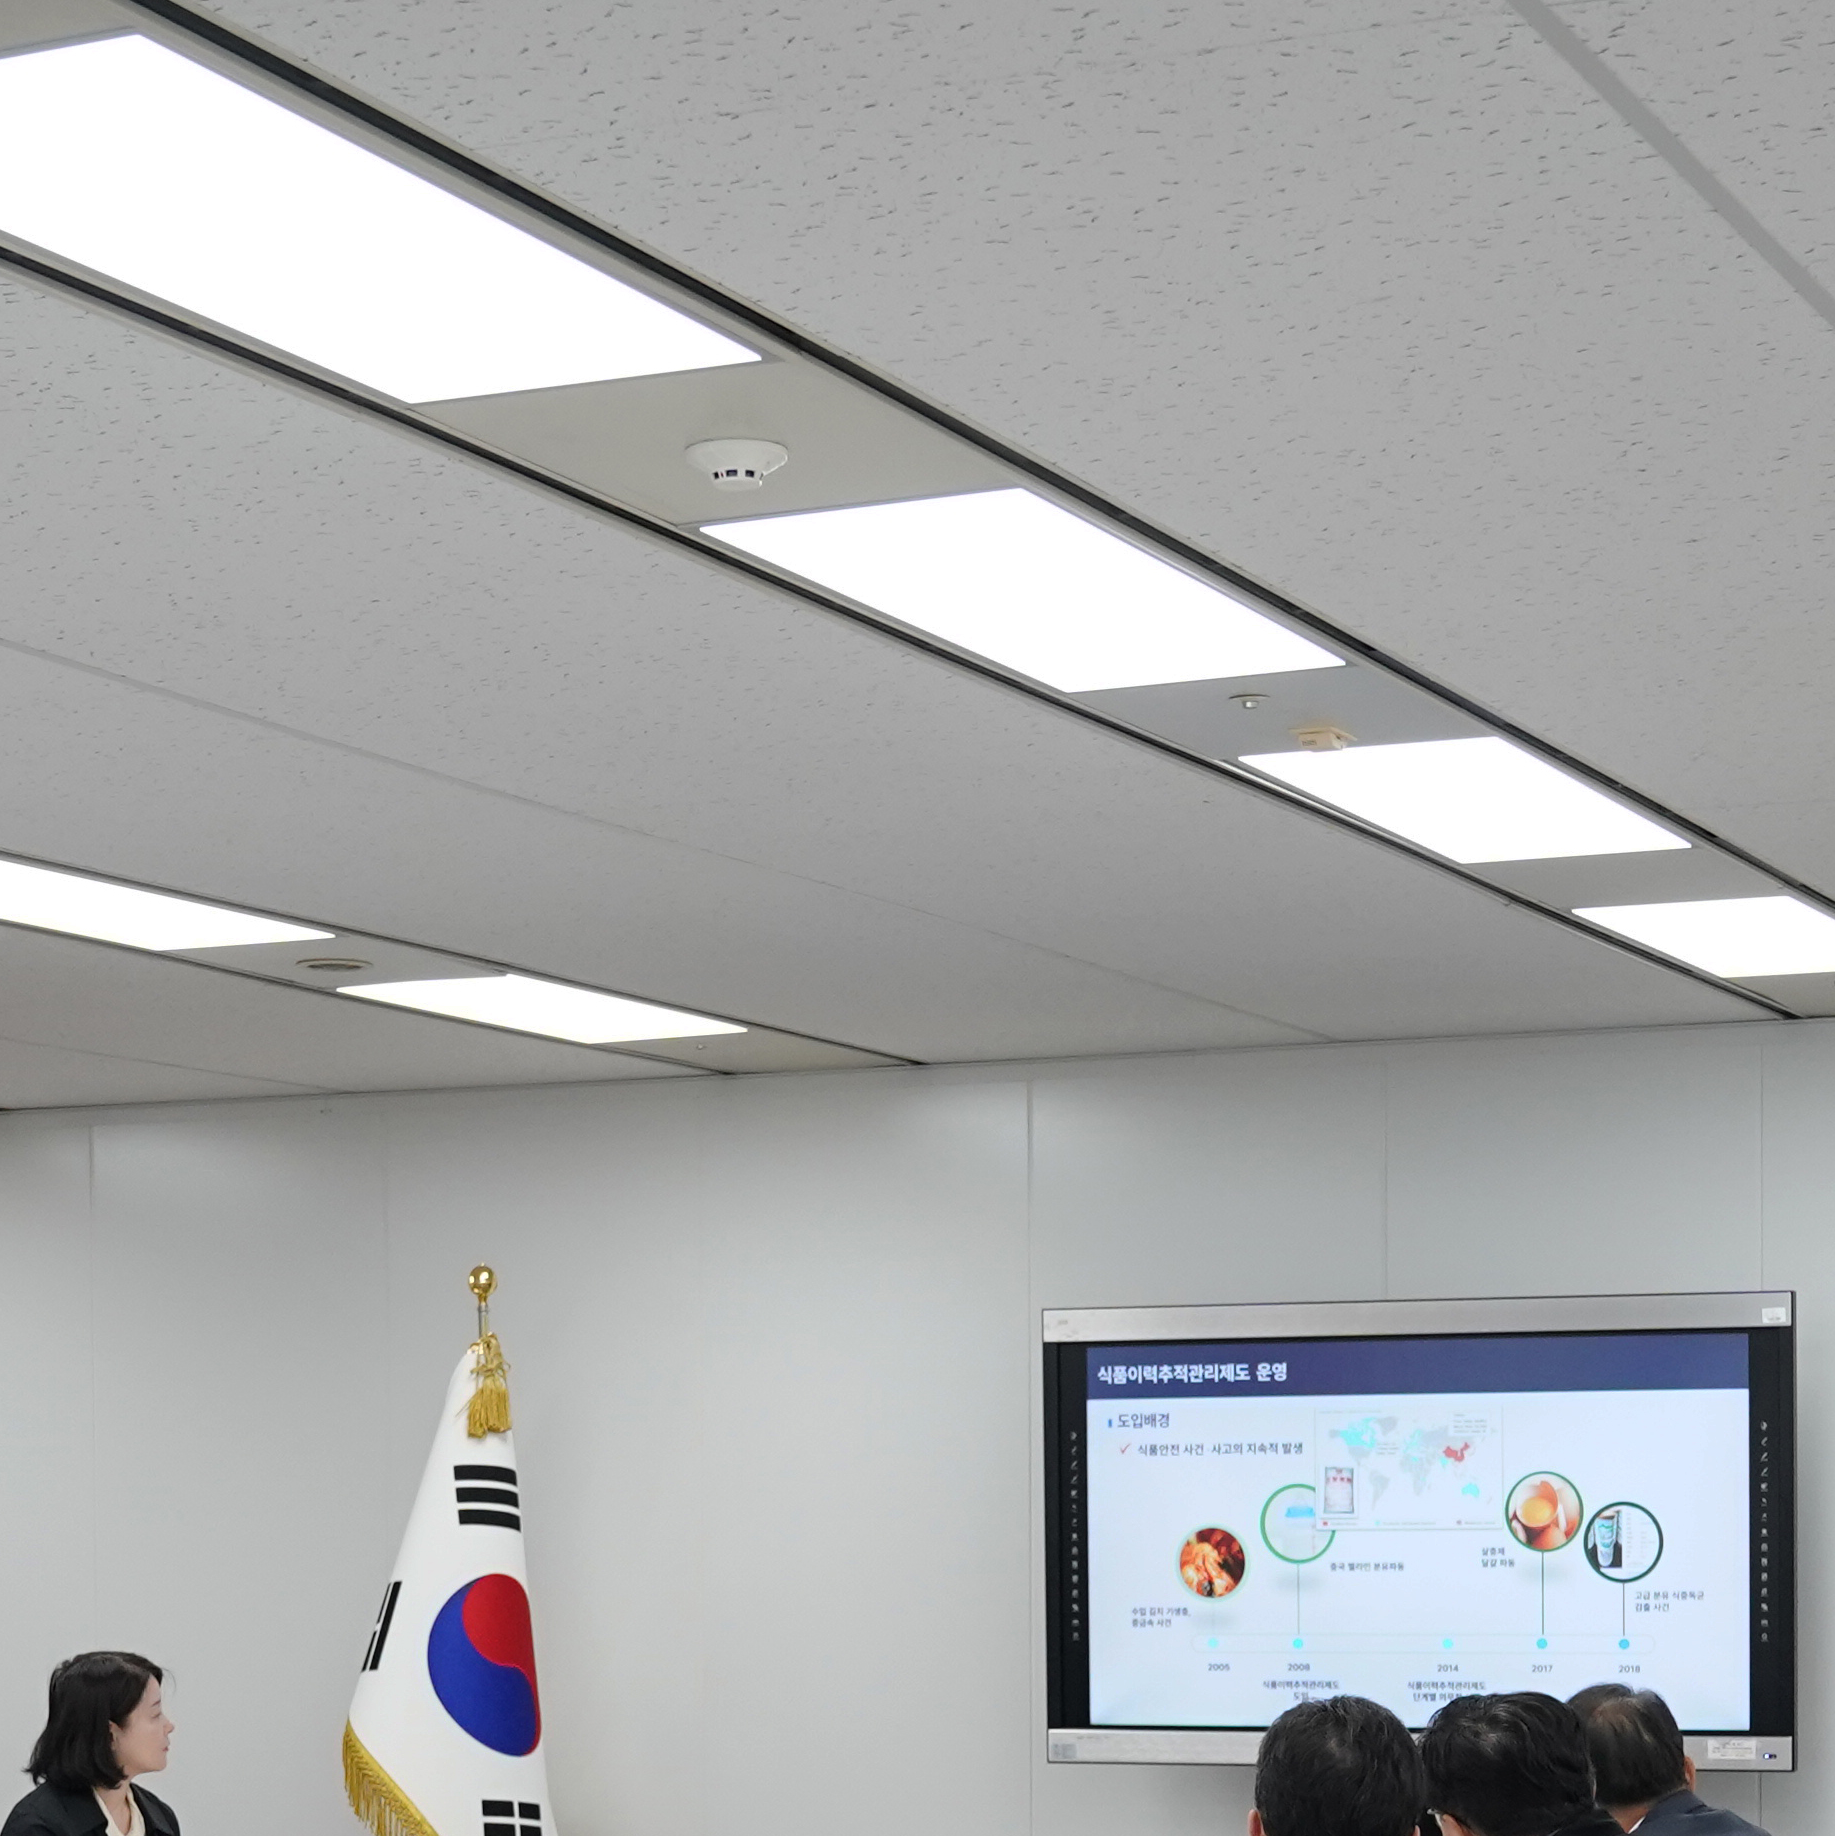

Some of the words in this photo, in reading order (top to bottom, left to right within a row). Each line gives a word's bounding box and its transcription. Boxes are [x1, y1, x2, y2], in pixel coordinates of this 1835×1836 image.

[1097, 1363, 1250, 1385] 식품이력추적관리제도
[1255, 1362, 1288, 1382] 운영
[1117, 1412, 1170, 1429] 도입배경
[1138, 1443, 1180, 1457] 식품안전
[1246, 1442, 1279, 1455] 지속적
[1282, 1441, 1303, 1455] 발생
[1207, 1663, 1230, 1671] 2005
[1287, 1663, 1311, 1671] 2008
[1437, 1664, 1459, 1672] 2014
[1531, 1664, 1553, 1673] 2017
[1618, 1665, 1641, 1673] 2018
